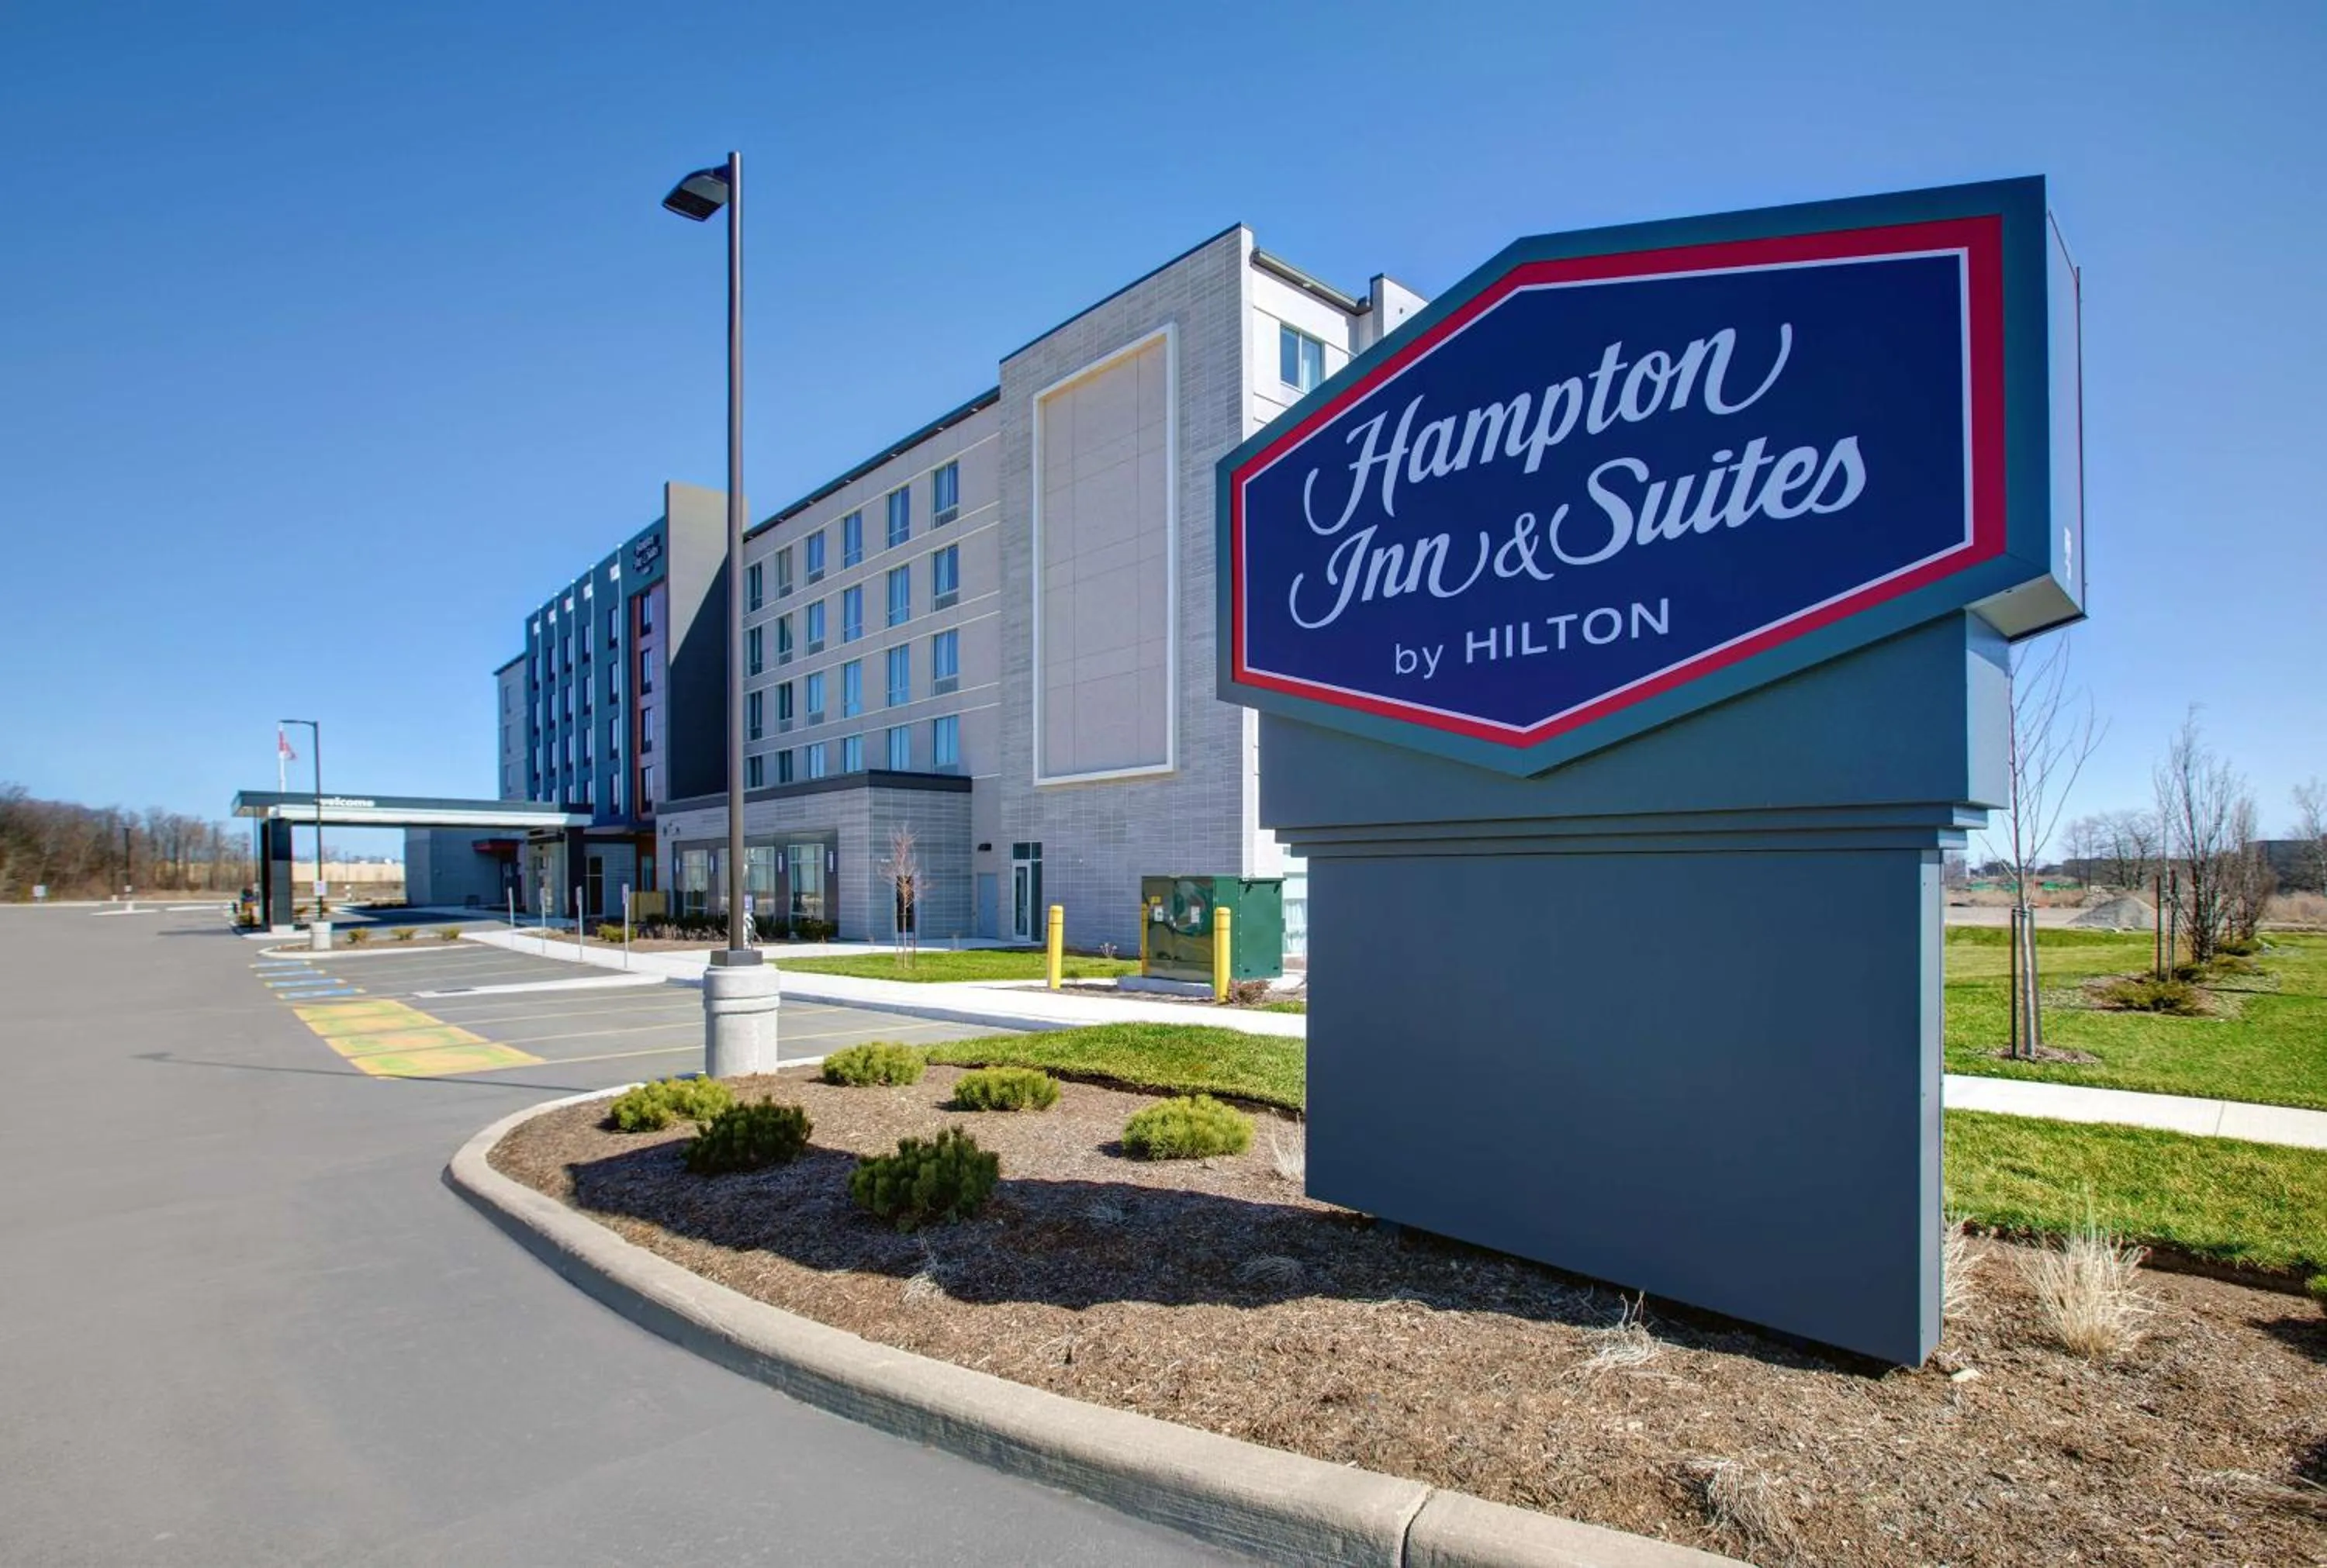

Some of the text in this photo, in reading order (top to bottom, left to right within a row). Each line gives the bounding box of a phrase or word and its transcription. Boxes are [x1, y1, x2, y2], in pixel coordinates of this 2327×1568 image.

[1304, 323, 1792, 535] Hampton
[1289, 436, 1867, 629] Inn & Suites
[1395, 598, 1669, 679] by HILTON
